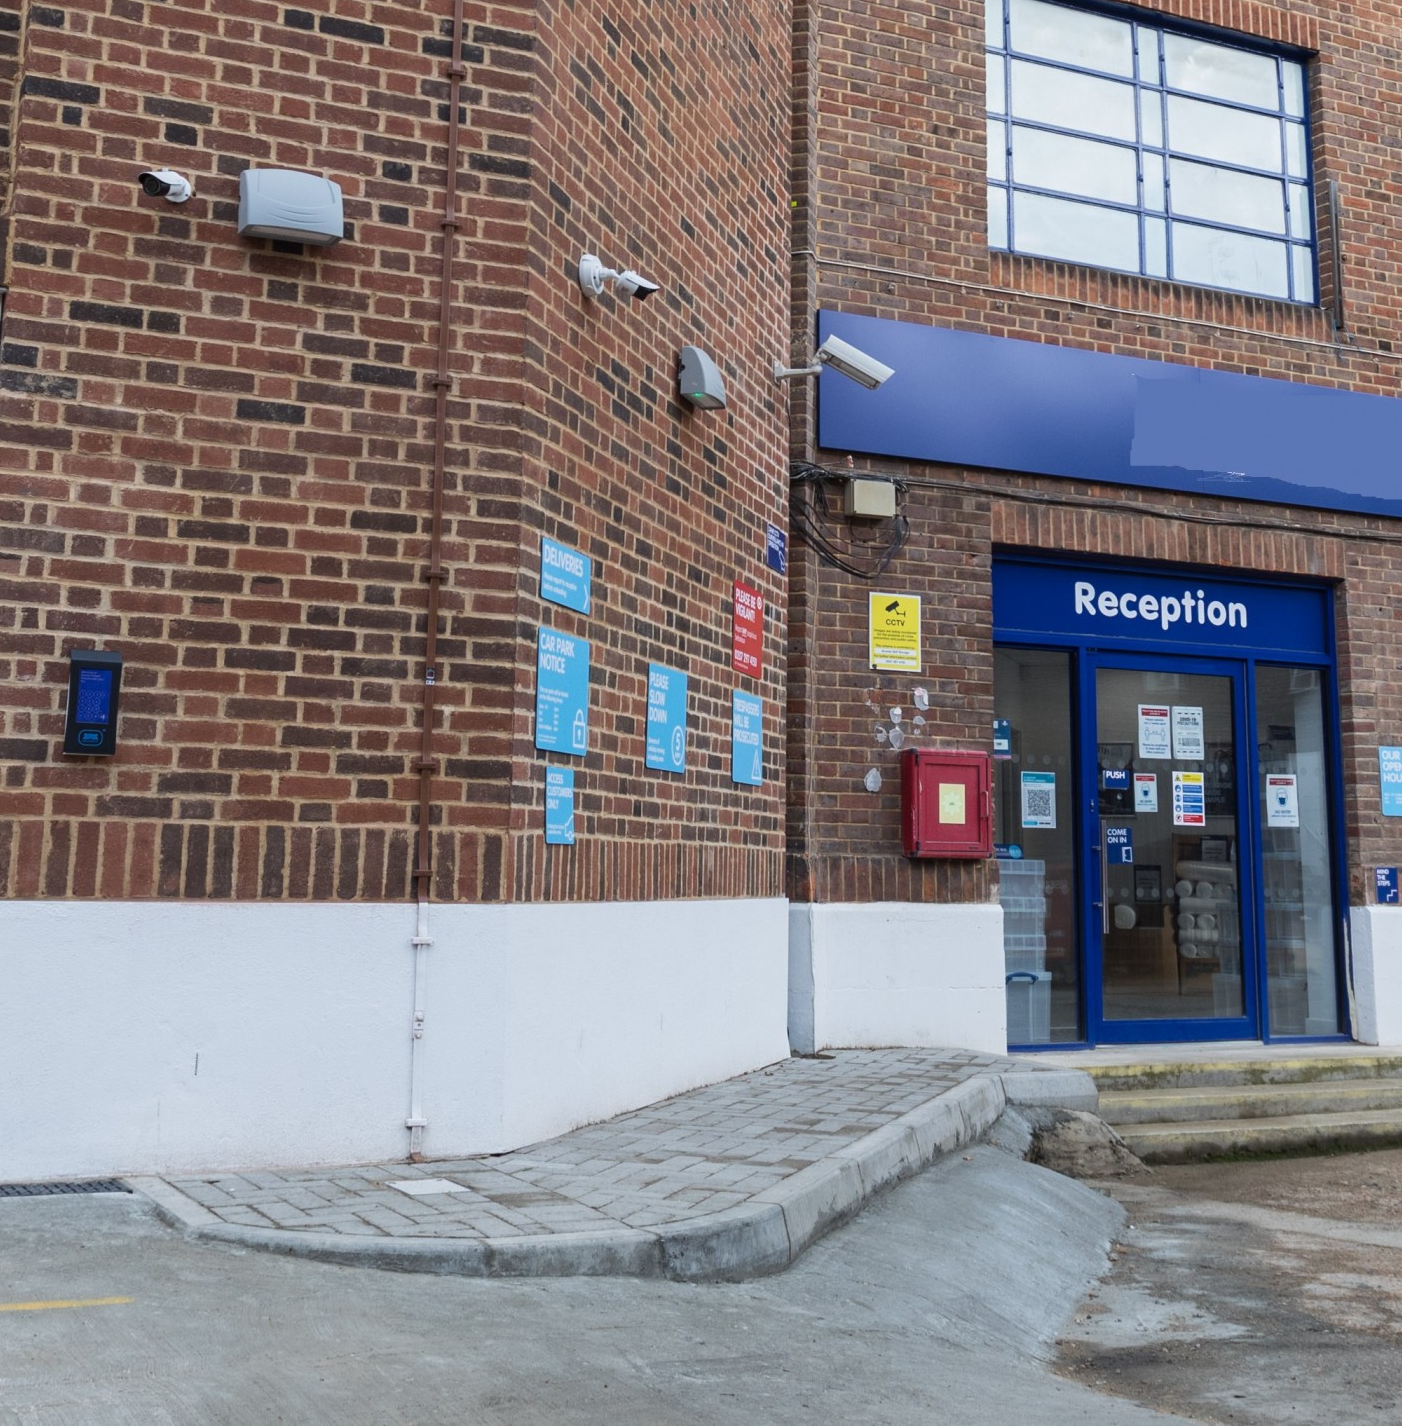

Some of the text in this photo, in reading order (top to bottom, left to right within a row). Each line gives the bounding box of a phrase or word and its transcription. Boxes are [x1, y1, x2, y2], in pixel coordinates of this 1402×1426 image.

[544, 544, 584, 578] DELIVERIES
[736, 588, 756, 609] PLEASE BE
[1074, 581, 1247, 631] Reception
[540, 633, 575, 658] CAR PARK
[540, 652, 566, 674] NOTICE
[649, 672, 669, 690] PLEASE
[649, 690, 666, 706] SLOW
[649, 707, 667, 724] DOWN
[734, 698, 759, 717] TRESPASSERS
[734, 715, 749, 729] WILL BE
[675, 733, 680, 751] 5
[734, 728, 759, 746] PROSECUTED
[1381, 750, 1401, 760] OUR
[1105, 770, 1126, 779] PUSH
